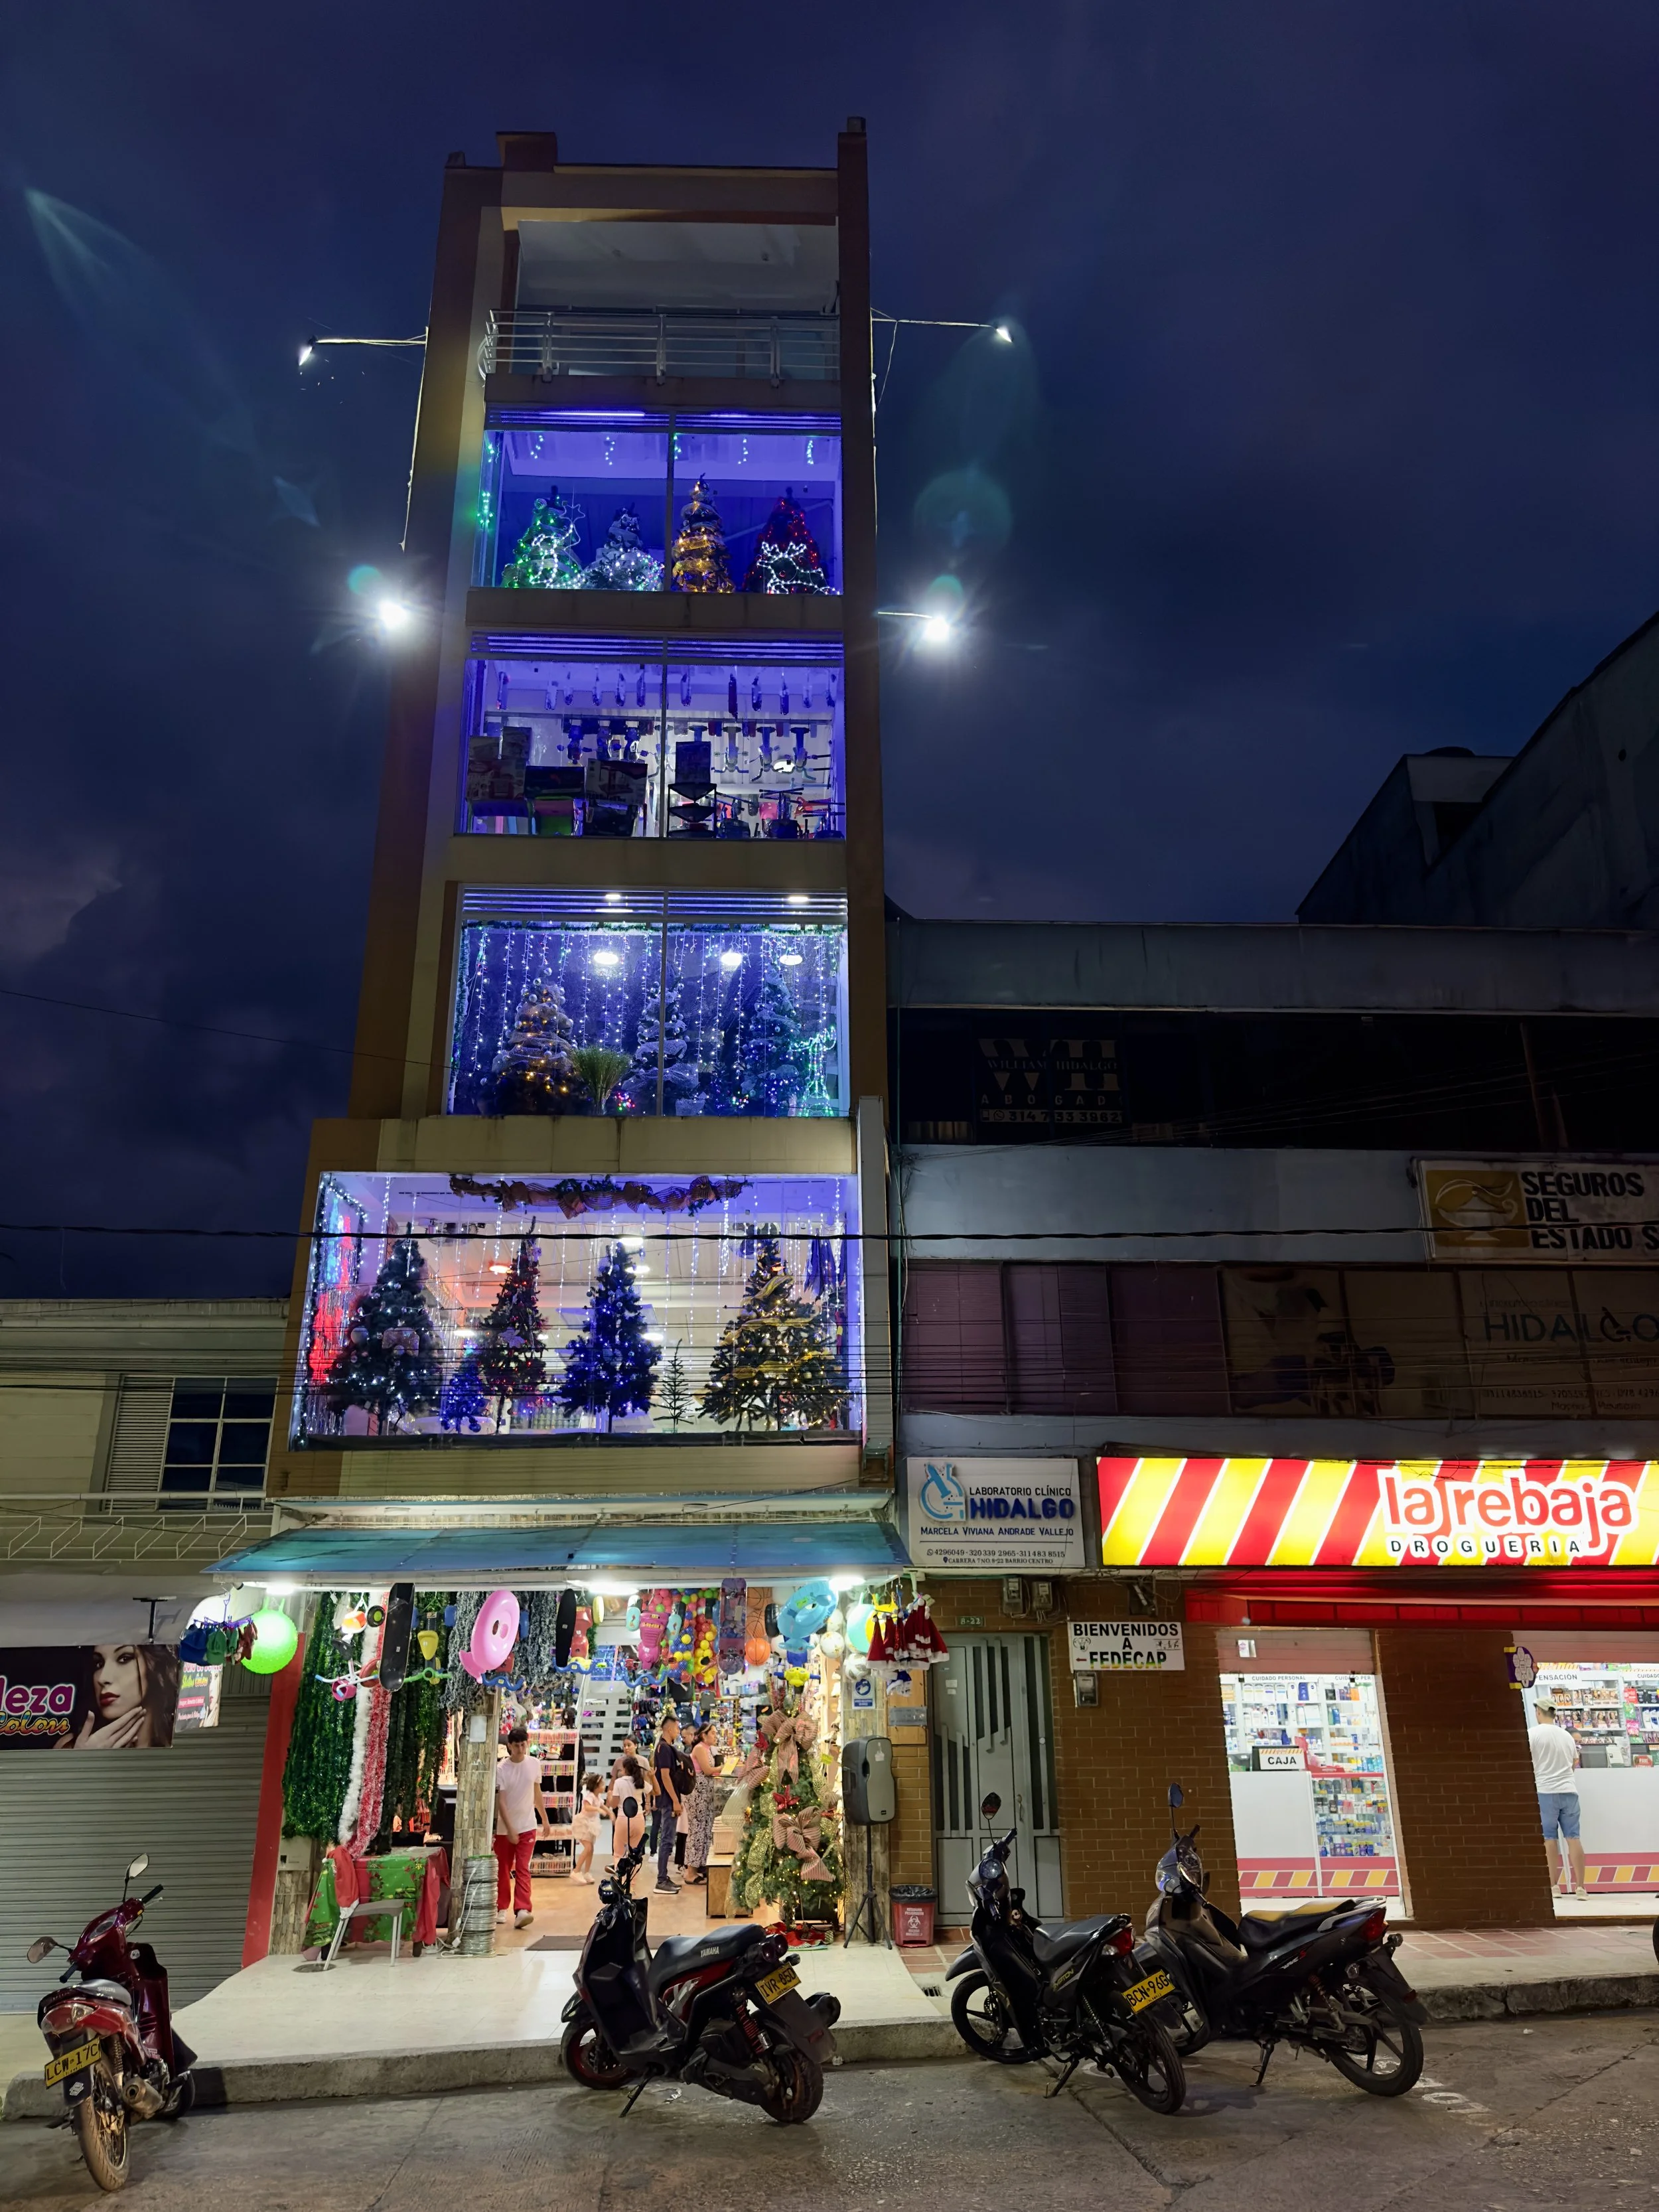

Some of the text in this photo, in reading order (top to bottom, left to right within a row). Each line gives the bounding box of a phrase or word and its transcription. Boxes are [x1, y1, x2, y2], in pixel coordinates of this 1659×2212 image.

[1056, 1060, 1118, 1070] HIDALGO
[1522, 1171, 1644, 1197] SEGUROS
[1526, 1197, 1579, 1222] DEL
[1531, 1226, 1632, 1249] ESTADO
[970, 1485, 1072, 1497] LABORATORIO CLÍNICO
[970, 1498, 1074, 1520] HIDALGO
[1453, 1476, 1632, 1542] rebaja
[920, 1526, 1074, 1536] MARCELA VIVIANA ANDRADE VALLEJO
[1390, 1540, 1580, 1554] DROGUERIA
[1073, 1623, 1179, 1636] BIENVENIDOS
[1122, 1637, 1133, 1650] A
[1089, 1651, 1167, 1669] FEDECAP
[1267, 1756, 1297, 1765] CAJA
[700, 1947, 720, 1958] YAMAHA
